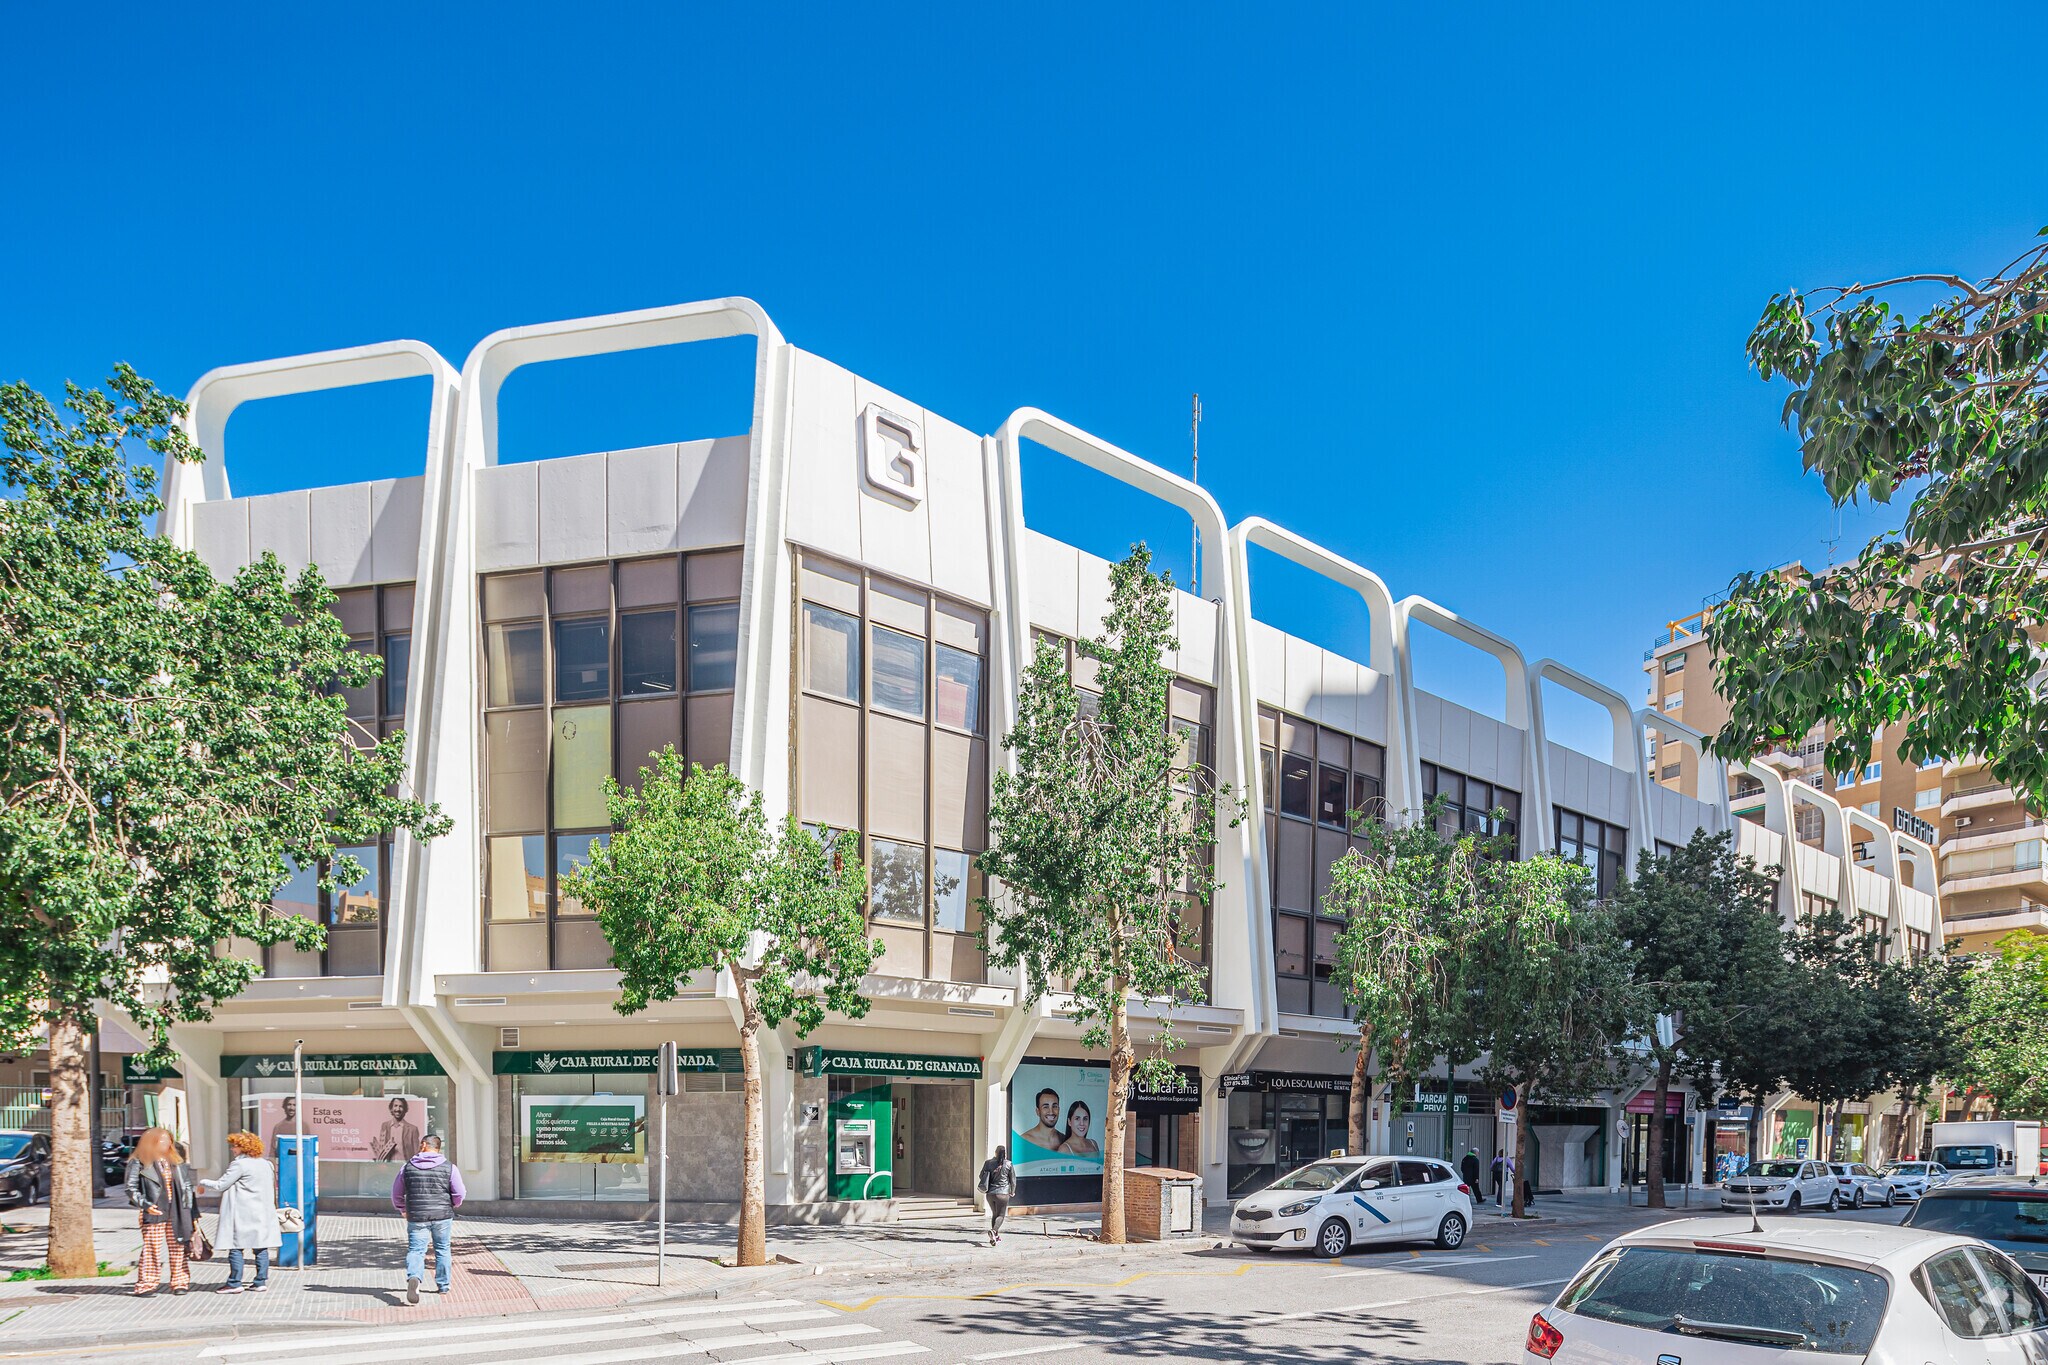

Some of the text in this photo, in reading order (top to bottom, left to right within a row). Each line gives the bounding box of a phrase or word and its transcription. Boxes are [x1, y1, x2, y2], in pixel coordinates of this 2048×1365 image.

[277, 1059, 417, 1071] CAJ RURAL DE GRANADA
[559, 1056, 716, 1068] CAJA RURAL DE GNADA
[832, 1057, 981, 1074] CAJA RURAL DE GRANADA
[1271, 1078, 1332, 1090] LOLA ESCALANTE
[1416, 1093, 1468, 1105] PARCAMNTO
[313, 1107, 331, 1116] Esta
[1423, 1104, 1460, 1112] PRIVAO
[323, 1116, 346, 1125] Casa,
[550, 1118, 571, 1126] quieren
[331, 1127, 348, 1135] esta
